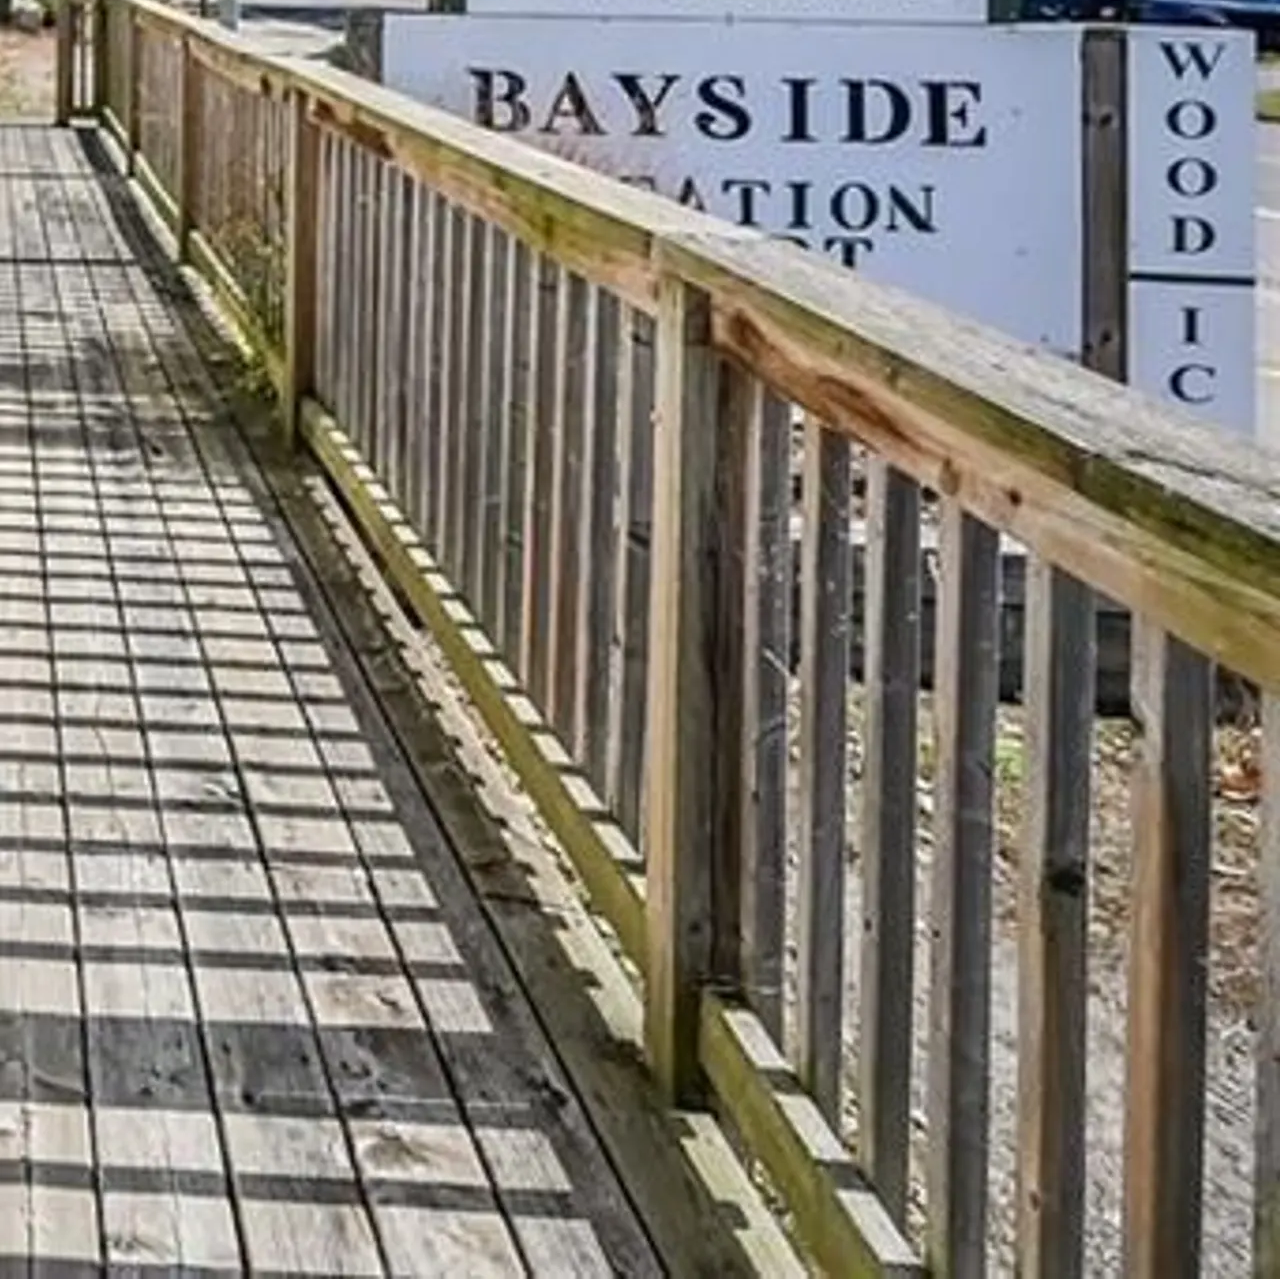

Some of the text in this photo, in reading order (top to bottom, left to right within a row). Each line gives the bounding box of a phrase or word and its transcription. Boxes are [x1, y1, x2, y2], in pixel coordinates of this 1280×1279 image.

[467, 67, 988, 148] BAYSIDE
[1159, 41, 1224, 255] WOOD
[622, 174, 939, 233] ATION
[1168, 306, 1216, 404] IC
